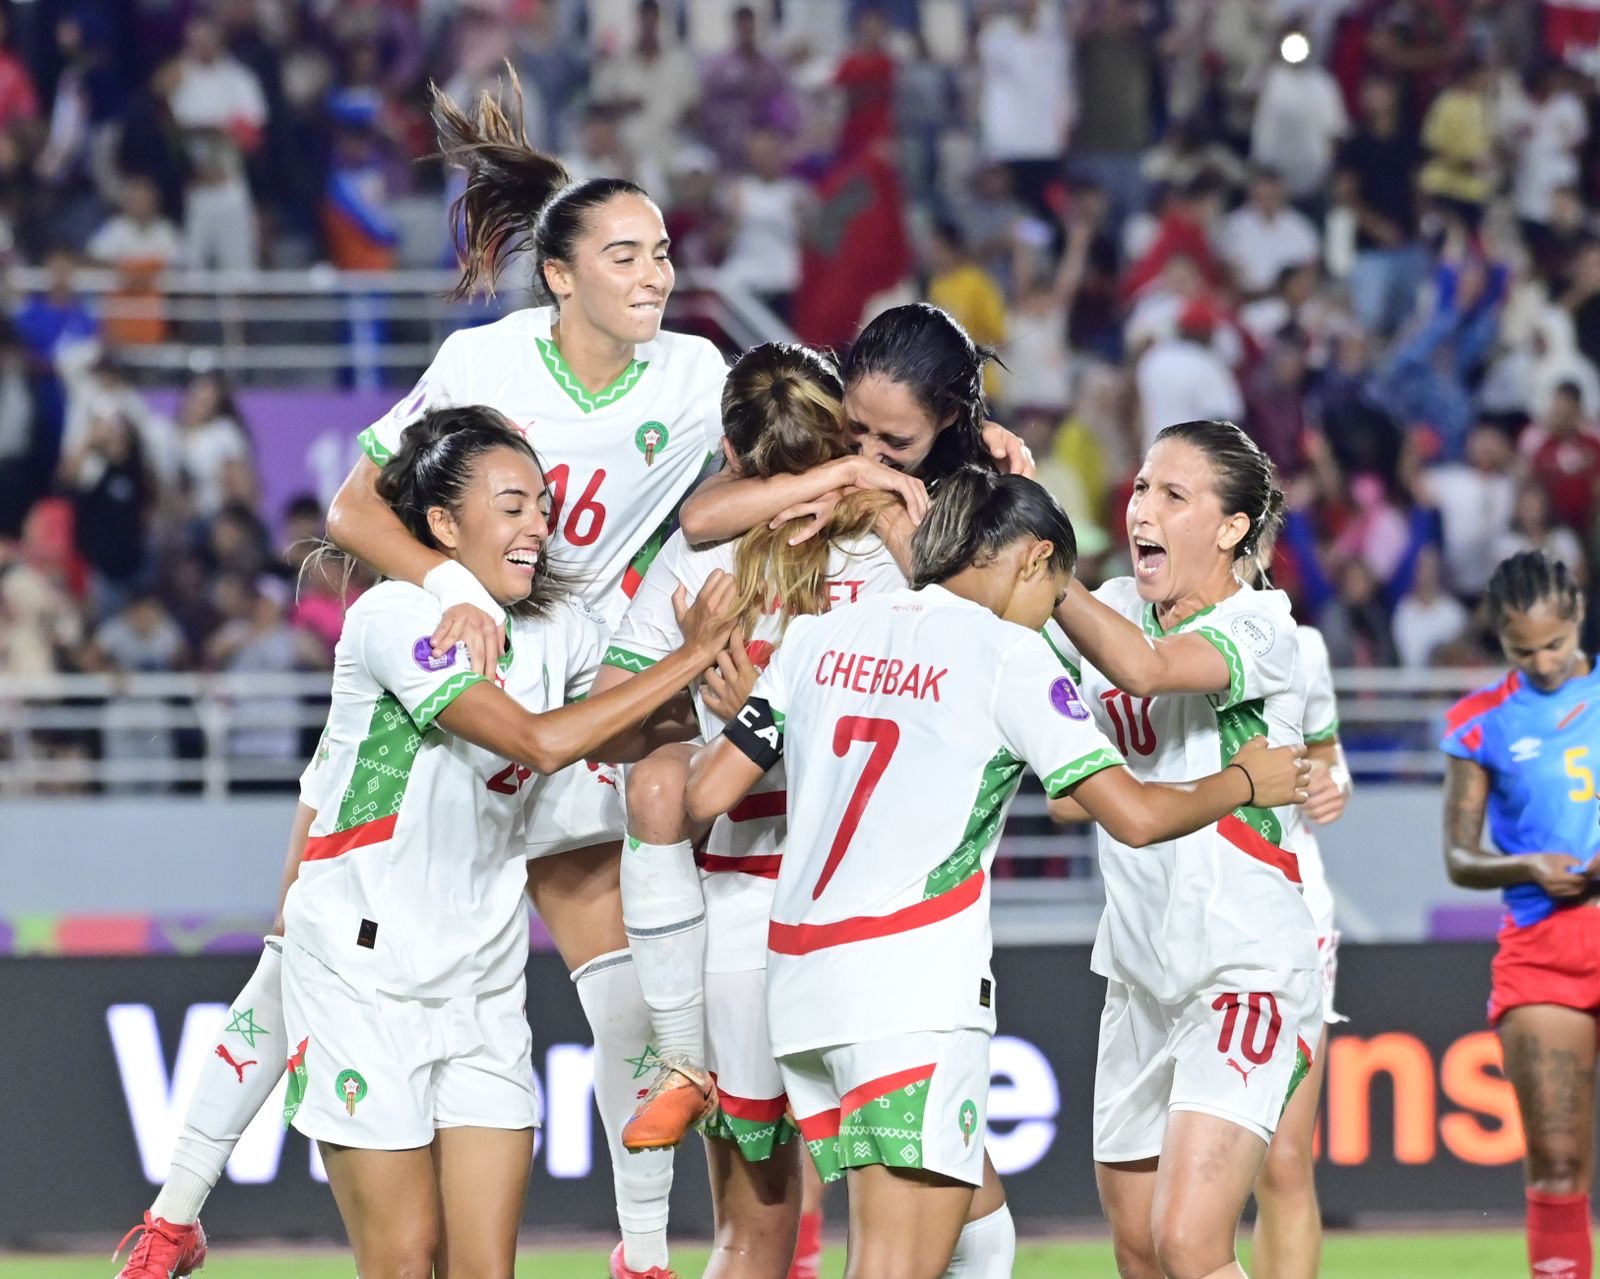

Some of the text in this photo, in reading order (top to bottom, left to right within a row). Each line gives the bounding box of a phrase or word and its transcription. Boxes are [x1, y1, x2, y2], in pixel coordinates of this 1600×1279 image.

[544, 463, 606, 547] 16
[737, 704, 783, 755] CA
[1100, 688, 1157, 757] 10
[812, 715, 900, 901] 7
[1564, 746, 1595, 802] 5
[1211, 991, 1282, 1065] 10
